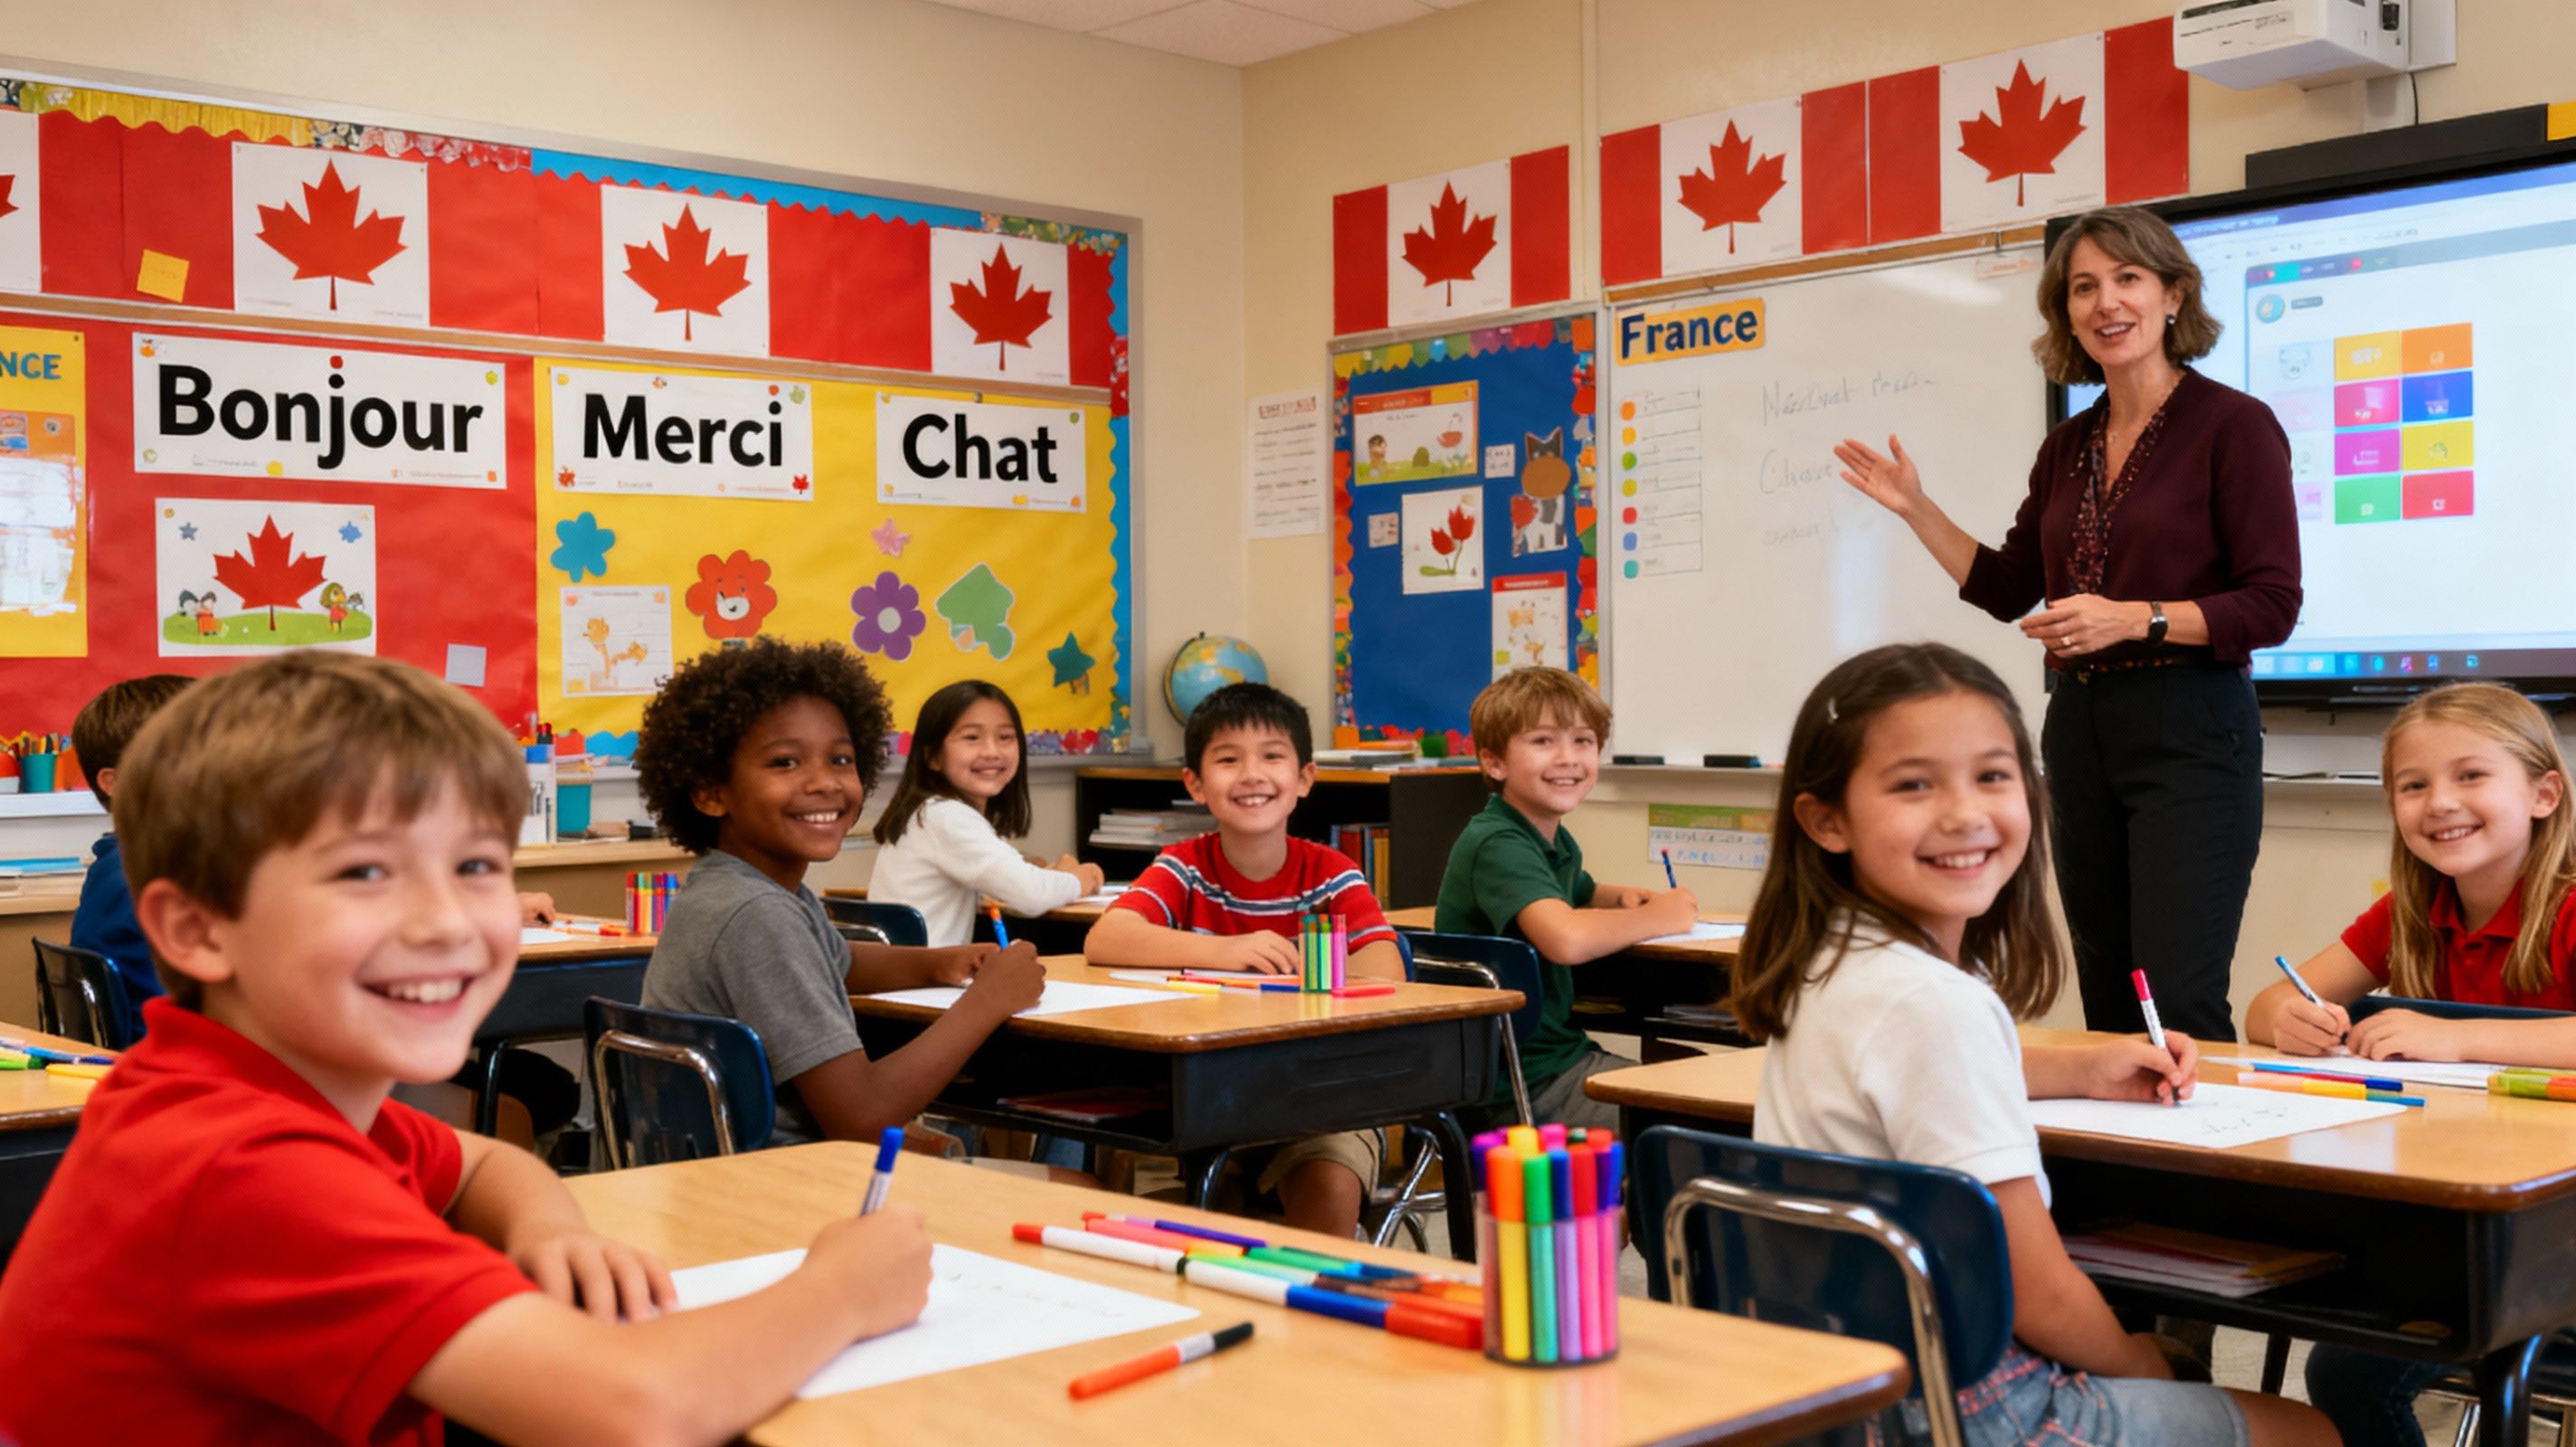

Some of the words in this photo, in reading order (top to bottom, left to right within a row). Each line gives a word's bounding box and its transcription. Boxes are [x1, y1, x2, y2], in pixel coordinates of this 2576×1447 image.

[1621, 310, 1758, 360] France
[158, 364, 484, 470] Bonjour
[582, 392, 784, 468] Merci
[902, 412, 1059, 485] Chat
